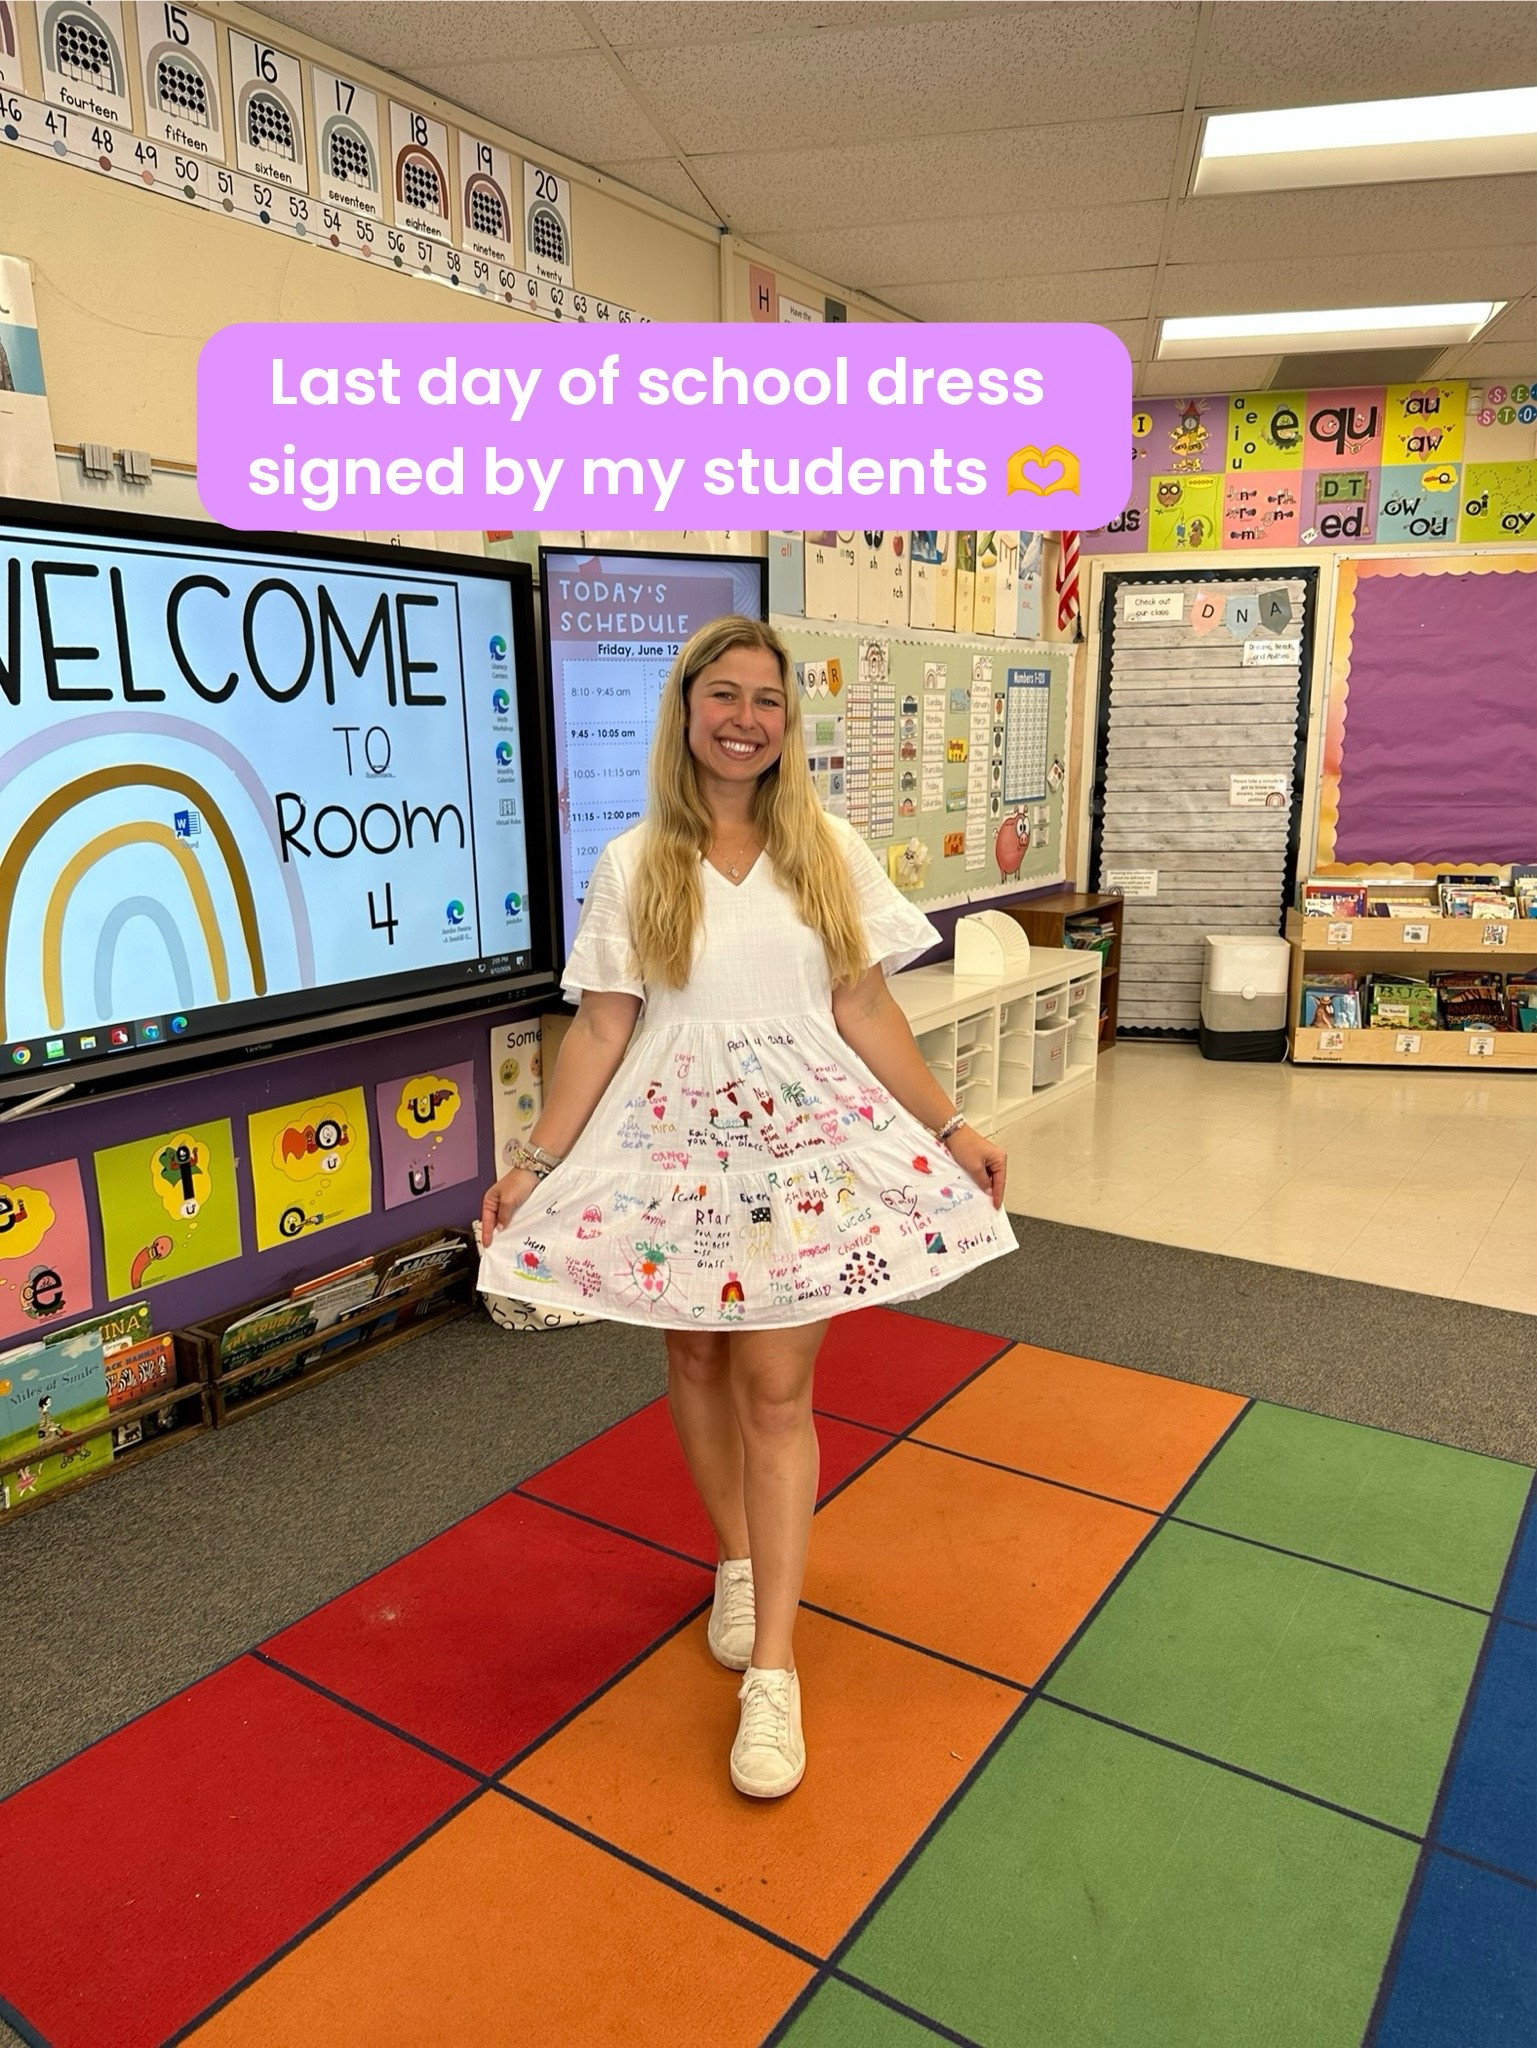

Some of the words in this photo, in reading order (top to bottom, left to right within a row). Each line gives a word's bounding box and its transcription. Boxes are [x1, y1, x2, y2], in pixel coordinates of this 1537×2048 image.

[164, 2, 190, 46] 15
[254, 43, 278, 84] 16
[60, 87, 119, 122] fourteen
[335, 79, 355, 115] 17
[165, 124, 208, 153] fifteen
[410, 112, 429, 147] 18
[477, 142, 493, 176] 19
[255, 162, 292, 184] sixteen
[535, 169, 558, 203] 20
[329, 190, 376, 215] seventeen
[45, 110, 67, 138] 47
[91, 126, 114, 153] 48
[135, 141, 158, 169] 49
[175, 156, 199, 182] 50
[217, 172, 234, 196] 51
[253, 184, 272, 208] 52
[289, 199, 309, 221] 53
[323, 208, 342, 232] 54
[356, 220, 374, 243] 55
[387, 230, 405, 254] 56
[418, 241, 433, 263] 57
[447, 251, 461, 272] 58
[474, 260, 489, 281] 59
[499, 270, 516, 290] 60
[527, 279, 538, 298] 61
[551, 287, 564, 306] 62
[573, 295, 587, 314] 63
[596, 303, 610, 321] 64
[405, 217, 442, 238] eighteen
[473, 241, 506, 262] nineteen
[536, 264, 563, 284] twenty
[759, 285, 769, 312] H
[790, 306, 803, 317] Have
[803, 311, 811, 321] the
[1235, 398, 1244, 410] a
[1405, 398, 1440, 417] au
[1246, 412, 1258, 423] e
[1271, 410, 1299, 442] e
[1235, 426, 1239, 441] i
[1310, 407, 1377, 454] qu
[1244, 442, 1256, 454] o
[1407, 435, 1443, 453] aw
[1232, 458, 1242, 469] u
[1384, 498, 1420, 516] ow
[1321, 507, 1363, 538] ed
[1410, 517, 1448, 536] ou
[1502, 512, 1535, 534] oy
[816, 550, 824, 565] th
[869, 556, 878, 570] sh
[894, 564, 902, 576] ch
[559, 579, 667, 604] TODAY'S
[893, 586, 903, 599] tch
[1135, 598, 1156, 606] Check
[561, 612, 688, 634] SCHEDULE
[1150, 609, 1169, 617] class
[598, 644, 635, 656] Friday,
[637, 644, 664, 655] June
[667, 645, 679, 655] 12
[1014, 671, 1034, 684] Numbers
[571, 687, 589, 697] 8:10
[597, 687, 614, 697] 9:45
[571, 729, 589, 738] 9:45
[598, 729, 619, 738] 10:05
[333, 726, 391, 776] TO
[573, 769, 595, 779] 10:05
[603, 768, 624, 777] 11:15
[626, 769, 640, 777] am
[572, 813, 594, 821] 11:15
[603, 810, 624, 820] 12:00
[626, 811, 640, 820] pm
[577, 846, 598, 856] 12:00
[368, 882, 398, 945] 4
[507, 1030, 542, 1048] Some
[413, 1093, 435, 1123] u
[315, 1120, 341, 1150] o
[408, 1165, 430, 1196] u
[31, 1270, 63, 1311] e
[10, 1387, 42, 1409] Miles
[46, 1379, 58, 1392] of
[62, 1364, 100, 1386] Smiles
